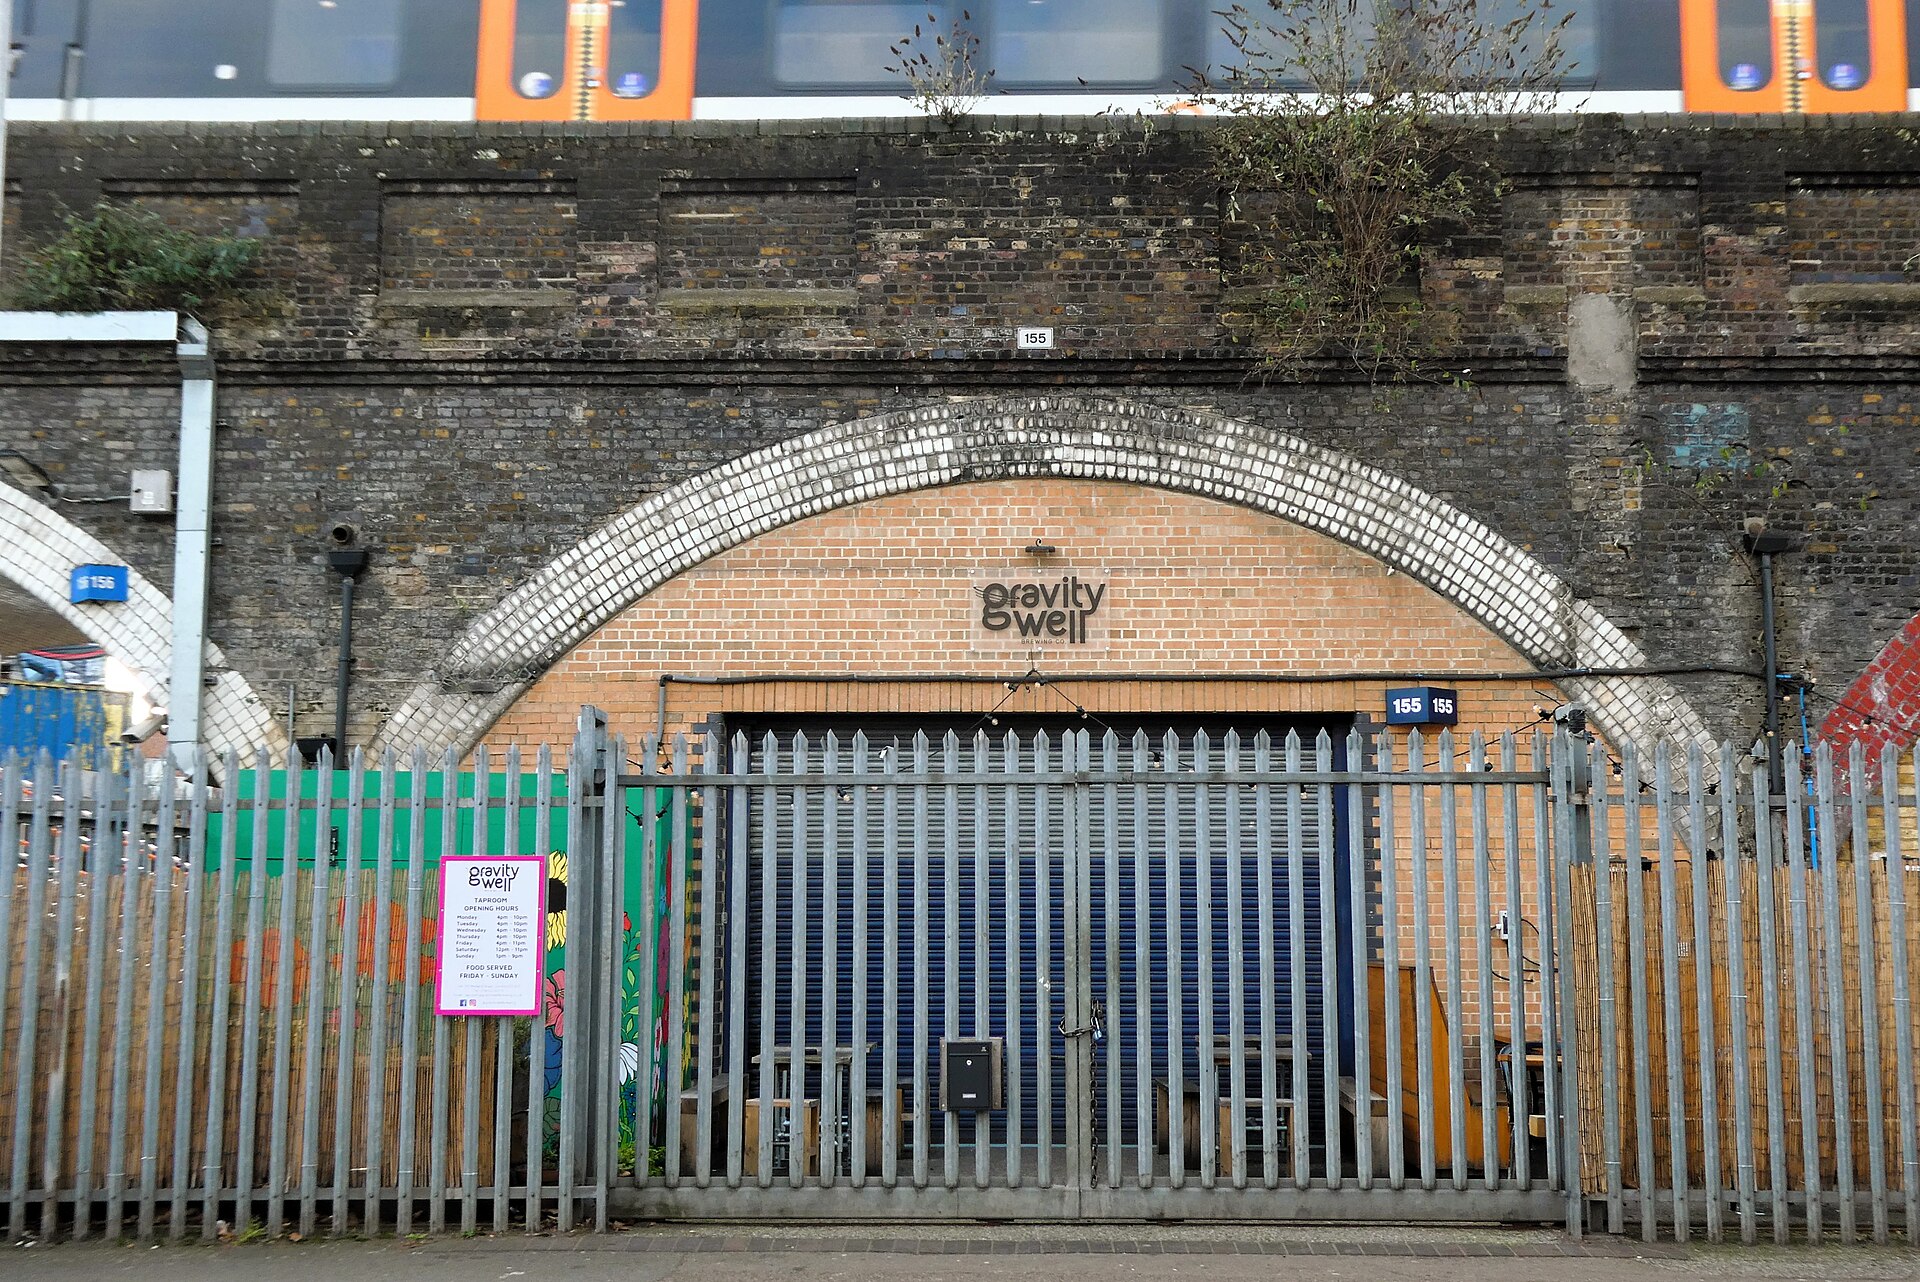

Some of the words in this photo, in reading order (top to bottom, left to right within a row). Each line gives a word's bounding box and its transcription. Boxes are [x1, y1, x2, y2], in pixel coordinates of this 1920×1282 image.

[1025, 333, 1046, 343] 155
[982, 576, 1106, 630] gravity
[1013, 610, 1085, 643] well
[1393, 698, 1421, 713] 155
[1433, 698, 1453, 714] 155
[469, 864, 519, 886] gravity
[482, 878, 511, 892] well
